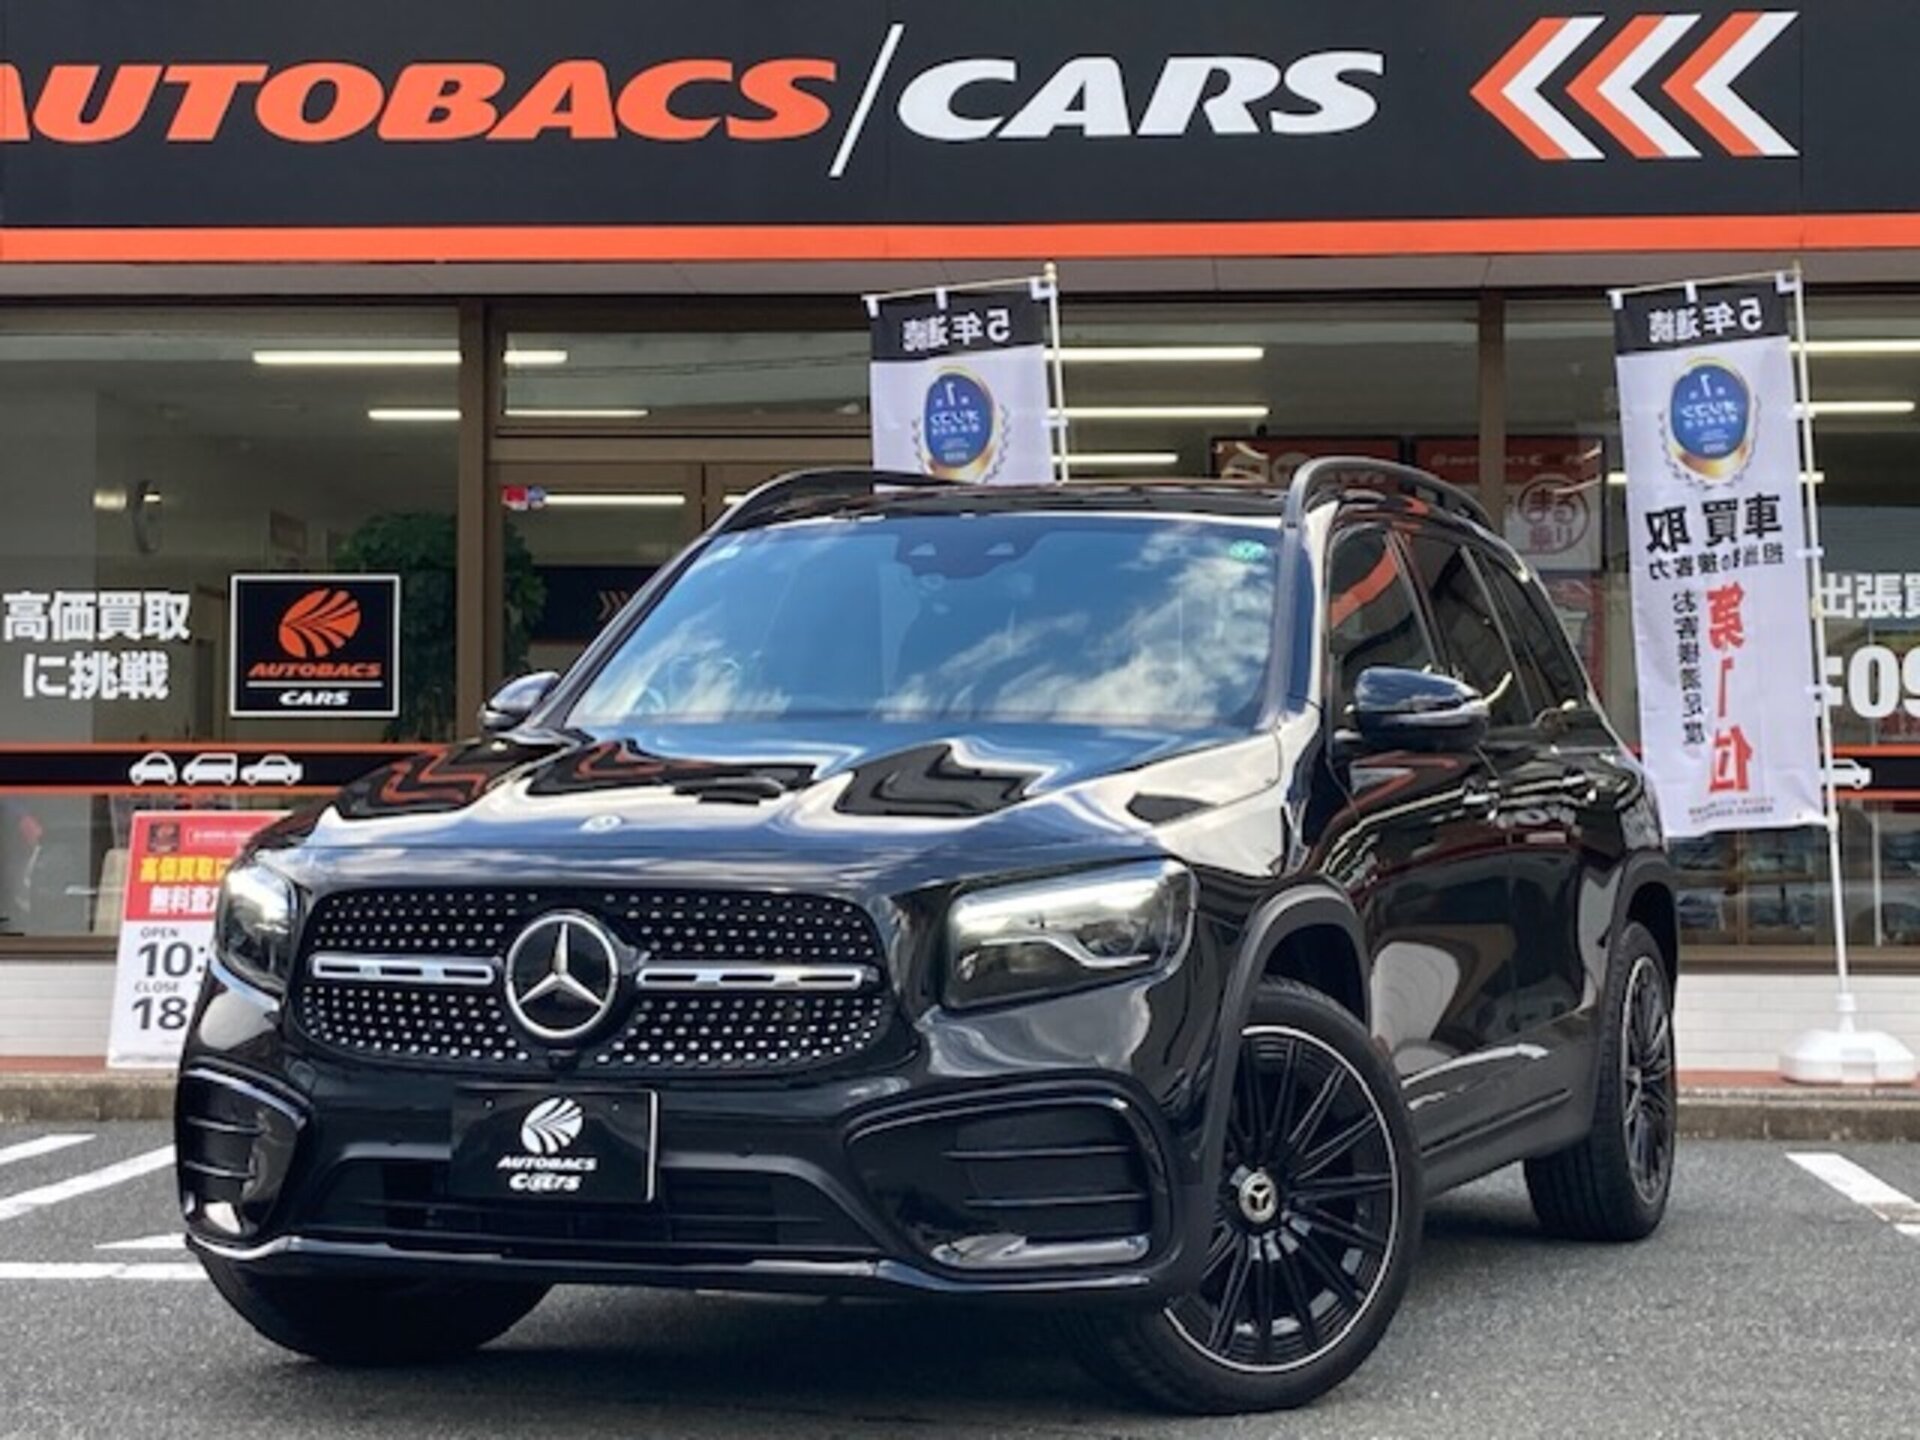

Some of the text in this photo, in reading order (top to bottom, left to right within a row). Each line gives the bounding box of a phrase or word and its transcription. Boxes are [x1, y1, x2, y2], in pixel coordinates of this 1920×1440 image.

[0, 51, 1384, 143] UTOBACS CARS
[2, 590, 191, 642] 高価買取
[22, 650, 170, 701] に挑戦
[246, 662, 382, 679] AUTOBACS
[278, 689, 349, 707] CARS
[140, 926, 180, 940] OPEN
[134, 981, 180, 994] CLOSE
[496, 1155, 598, 1171] AUTOBACS
